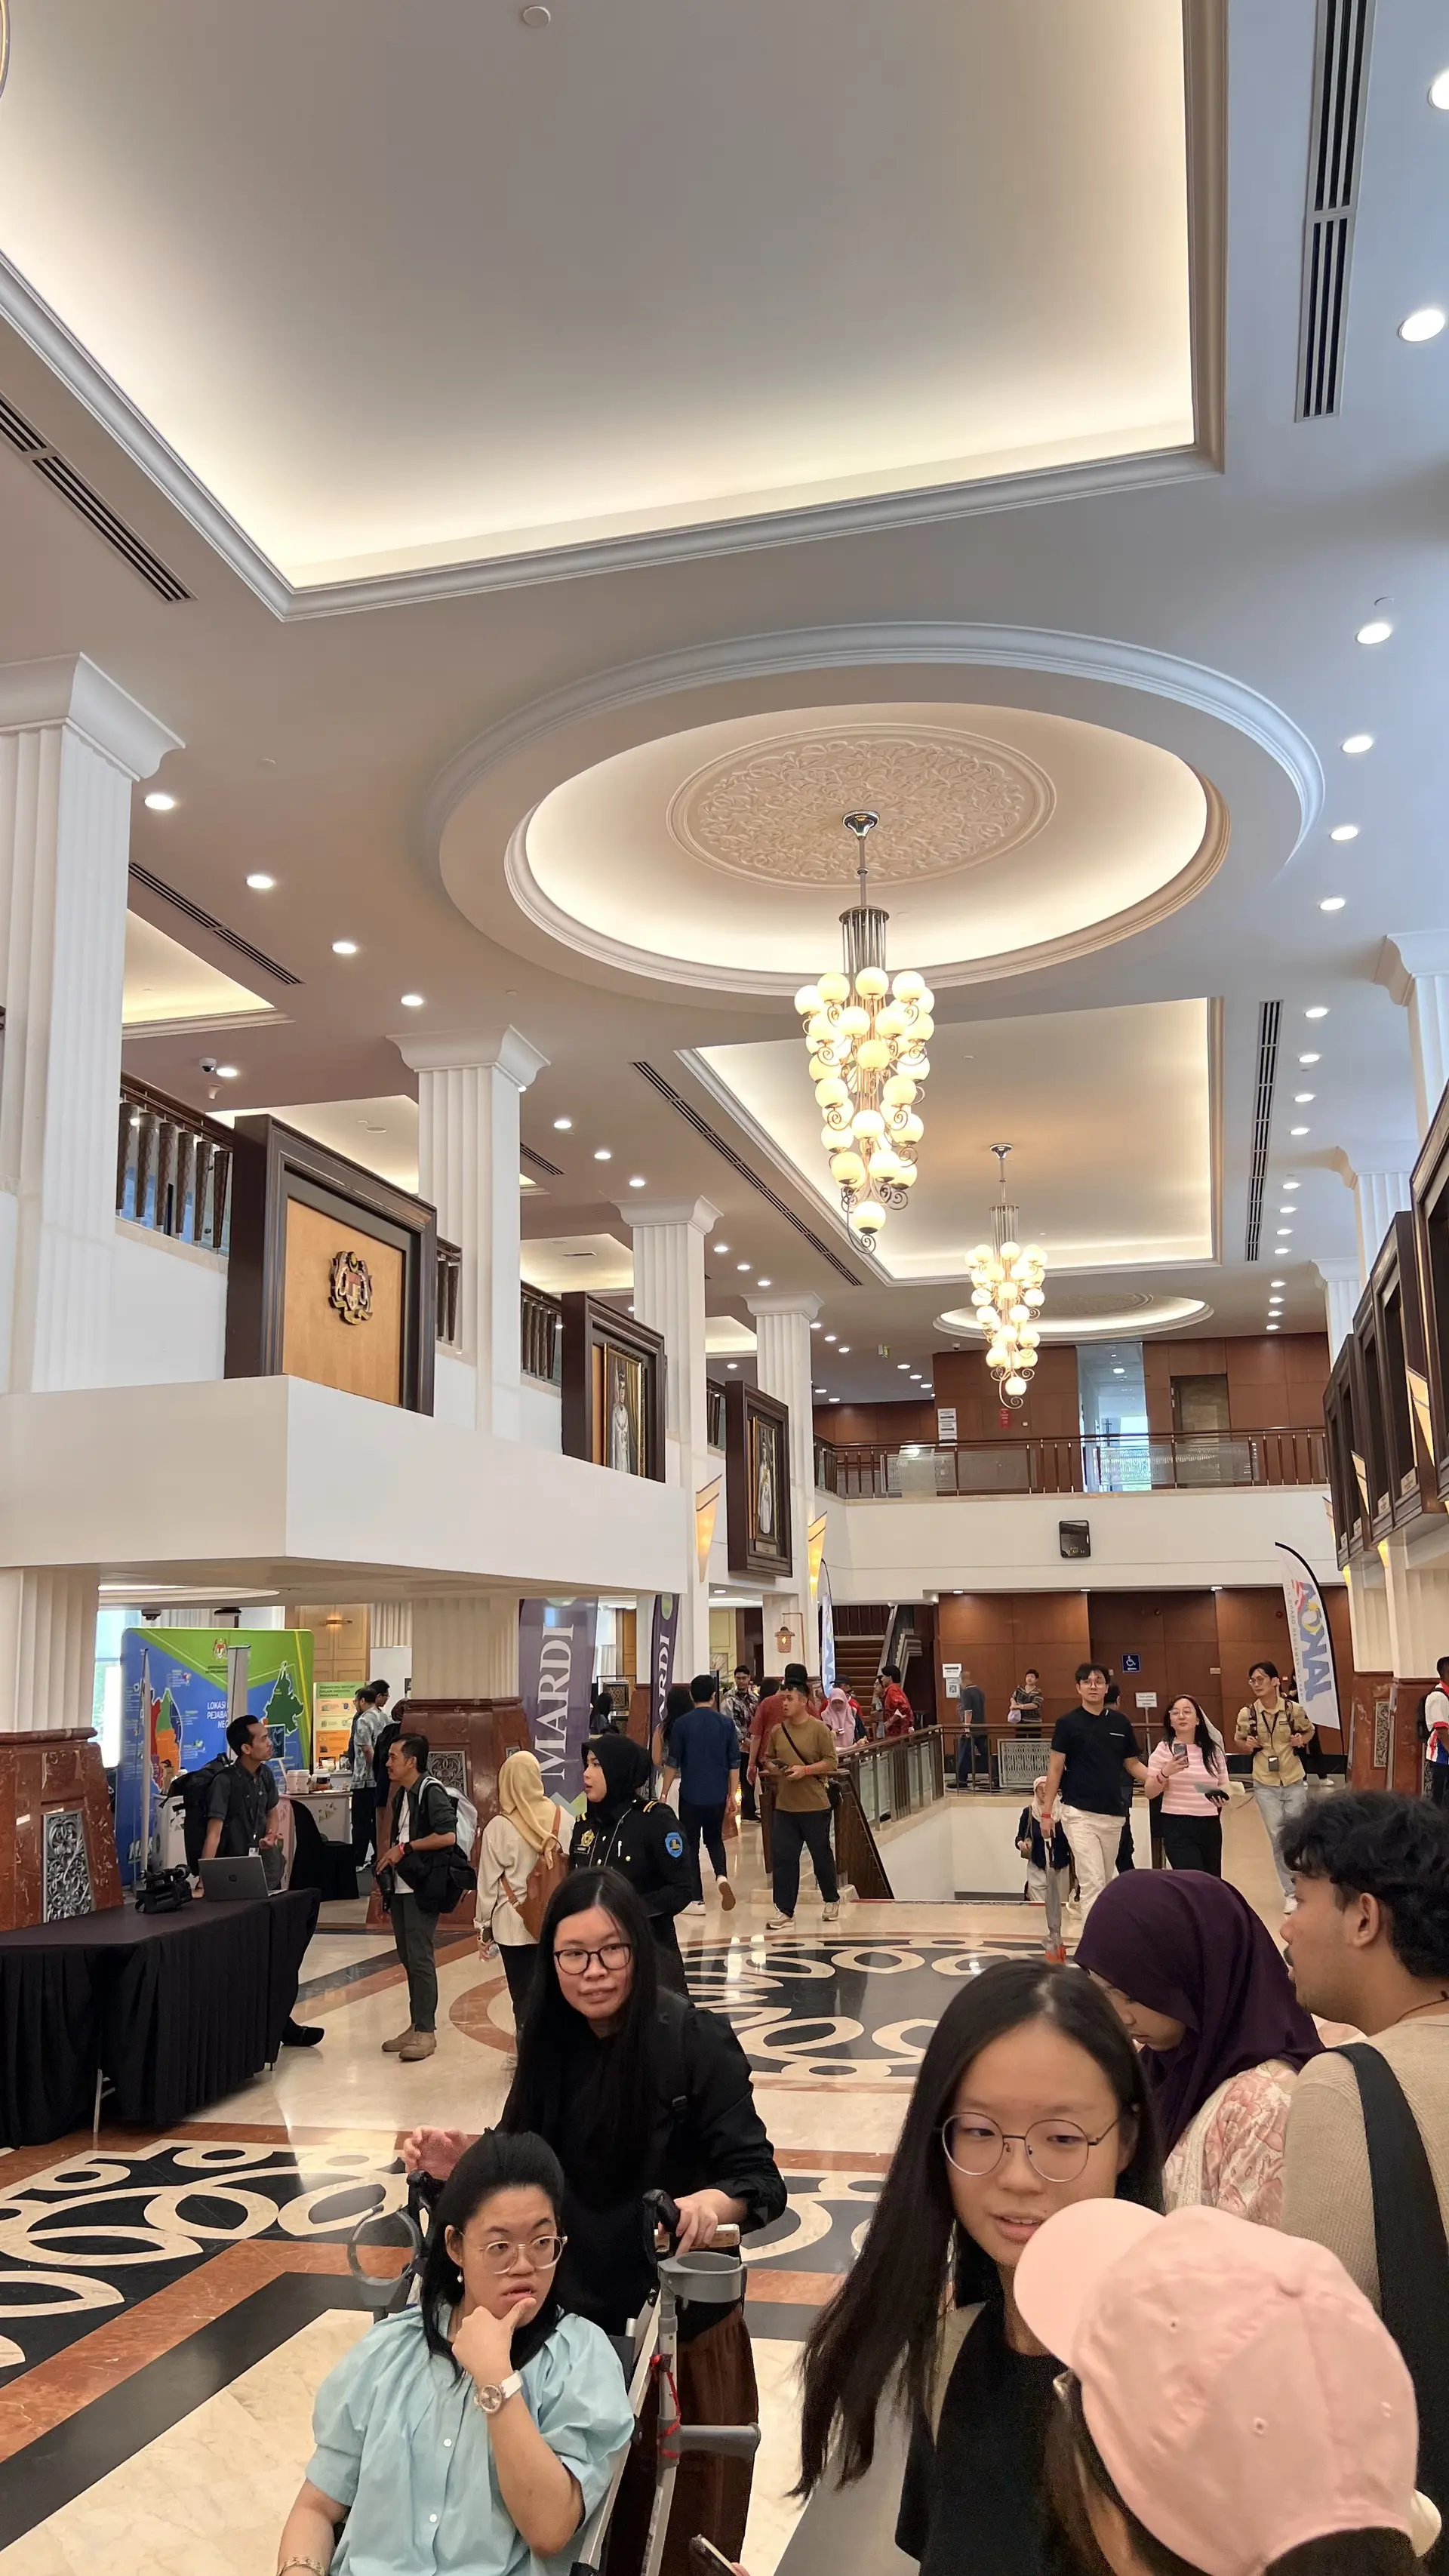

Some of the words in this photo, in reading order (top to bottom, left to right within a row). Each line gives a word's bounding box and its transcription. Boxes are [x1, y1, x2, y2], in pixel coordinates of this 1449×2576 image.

[534, 1623, 574, 1780] MARDI
[658, 1633, 669, 1722] ARDI
[207, 1700, 226, 1710] LOKASI
[207, 1710, 228, 1719] PEJABA
